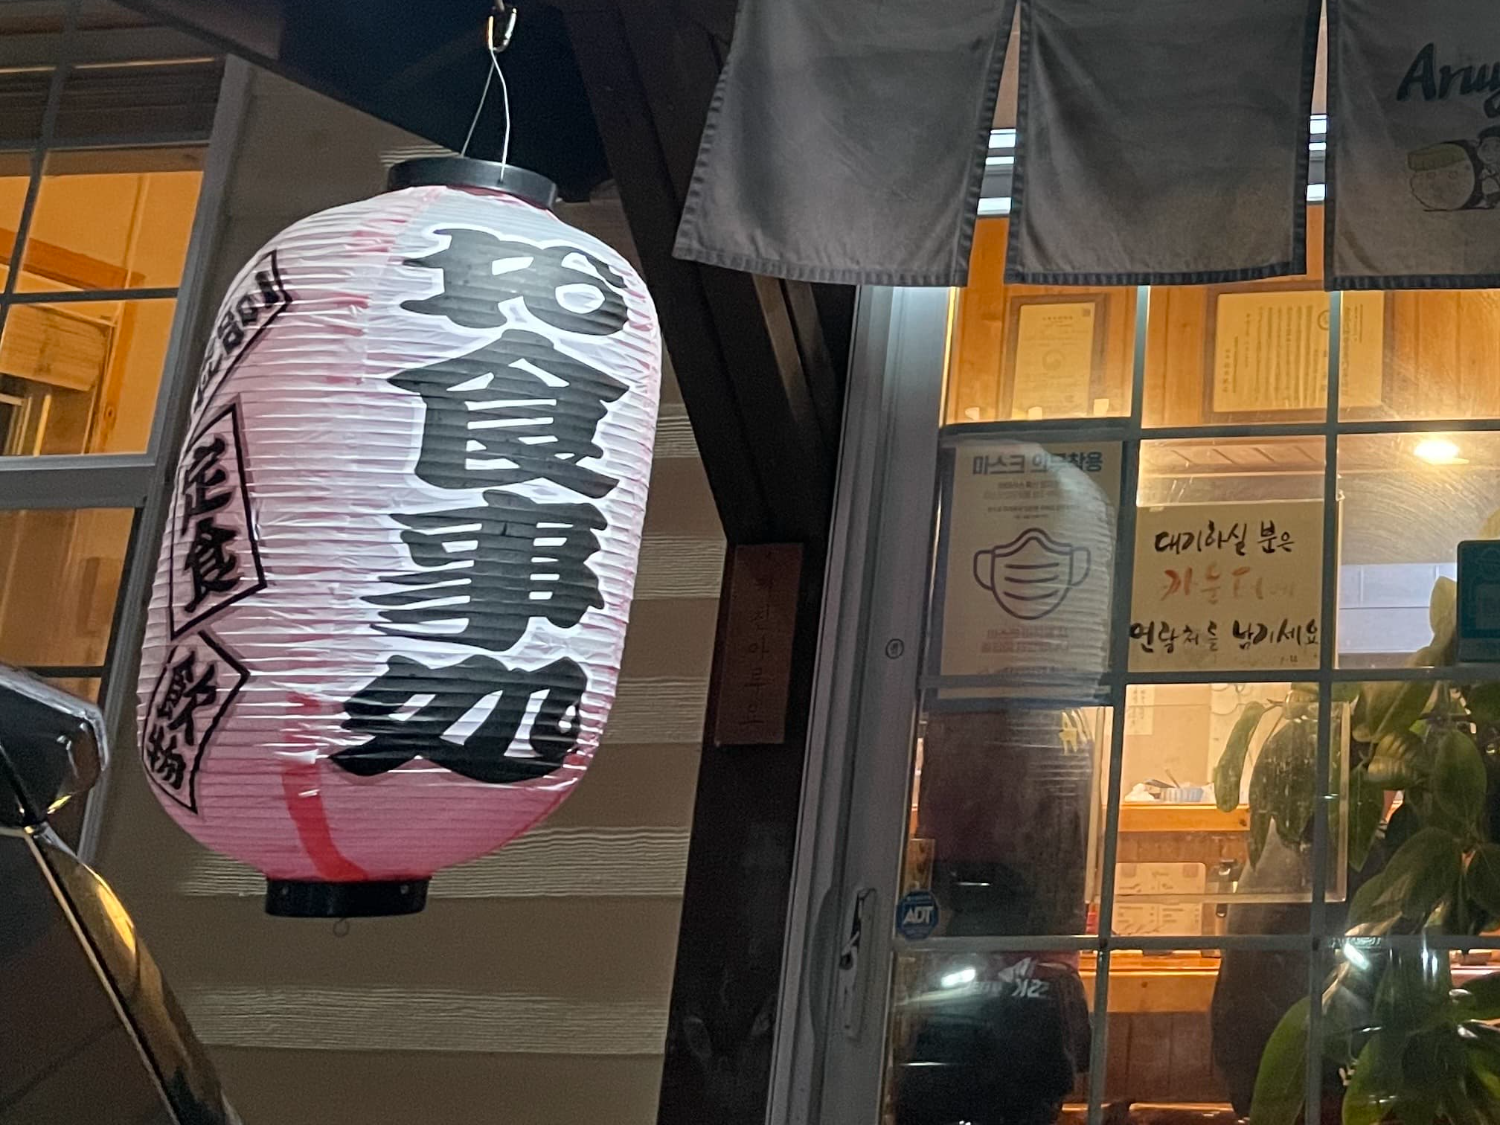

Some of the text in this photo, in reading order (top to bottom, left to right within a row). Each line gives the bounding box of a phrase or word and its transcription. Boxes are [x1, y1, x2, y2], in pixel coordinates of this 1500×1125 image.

[972, 453, 1026, 476] 마스크
[1154, 519, 1296, 556] 대기하실 분은
[1129, 618, 1320, 654] 연락처를 남기세요
[903, 905, 934, 925] ADT
